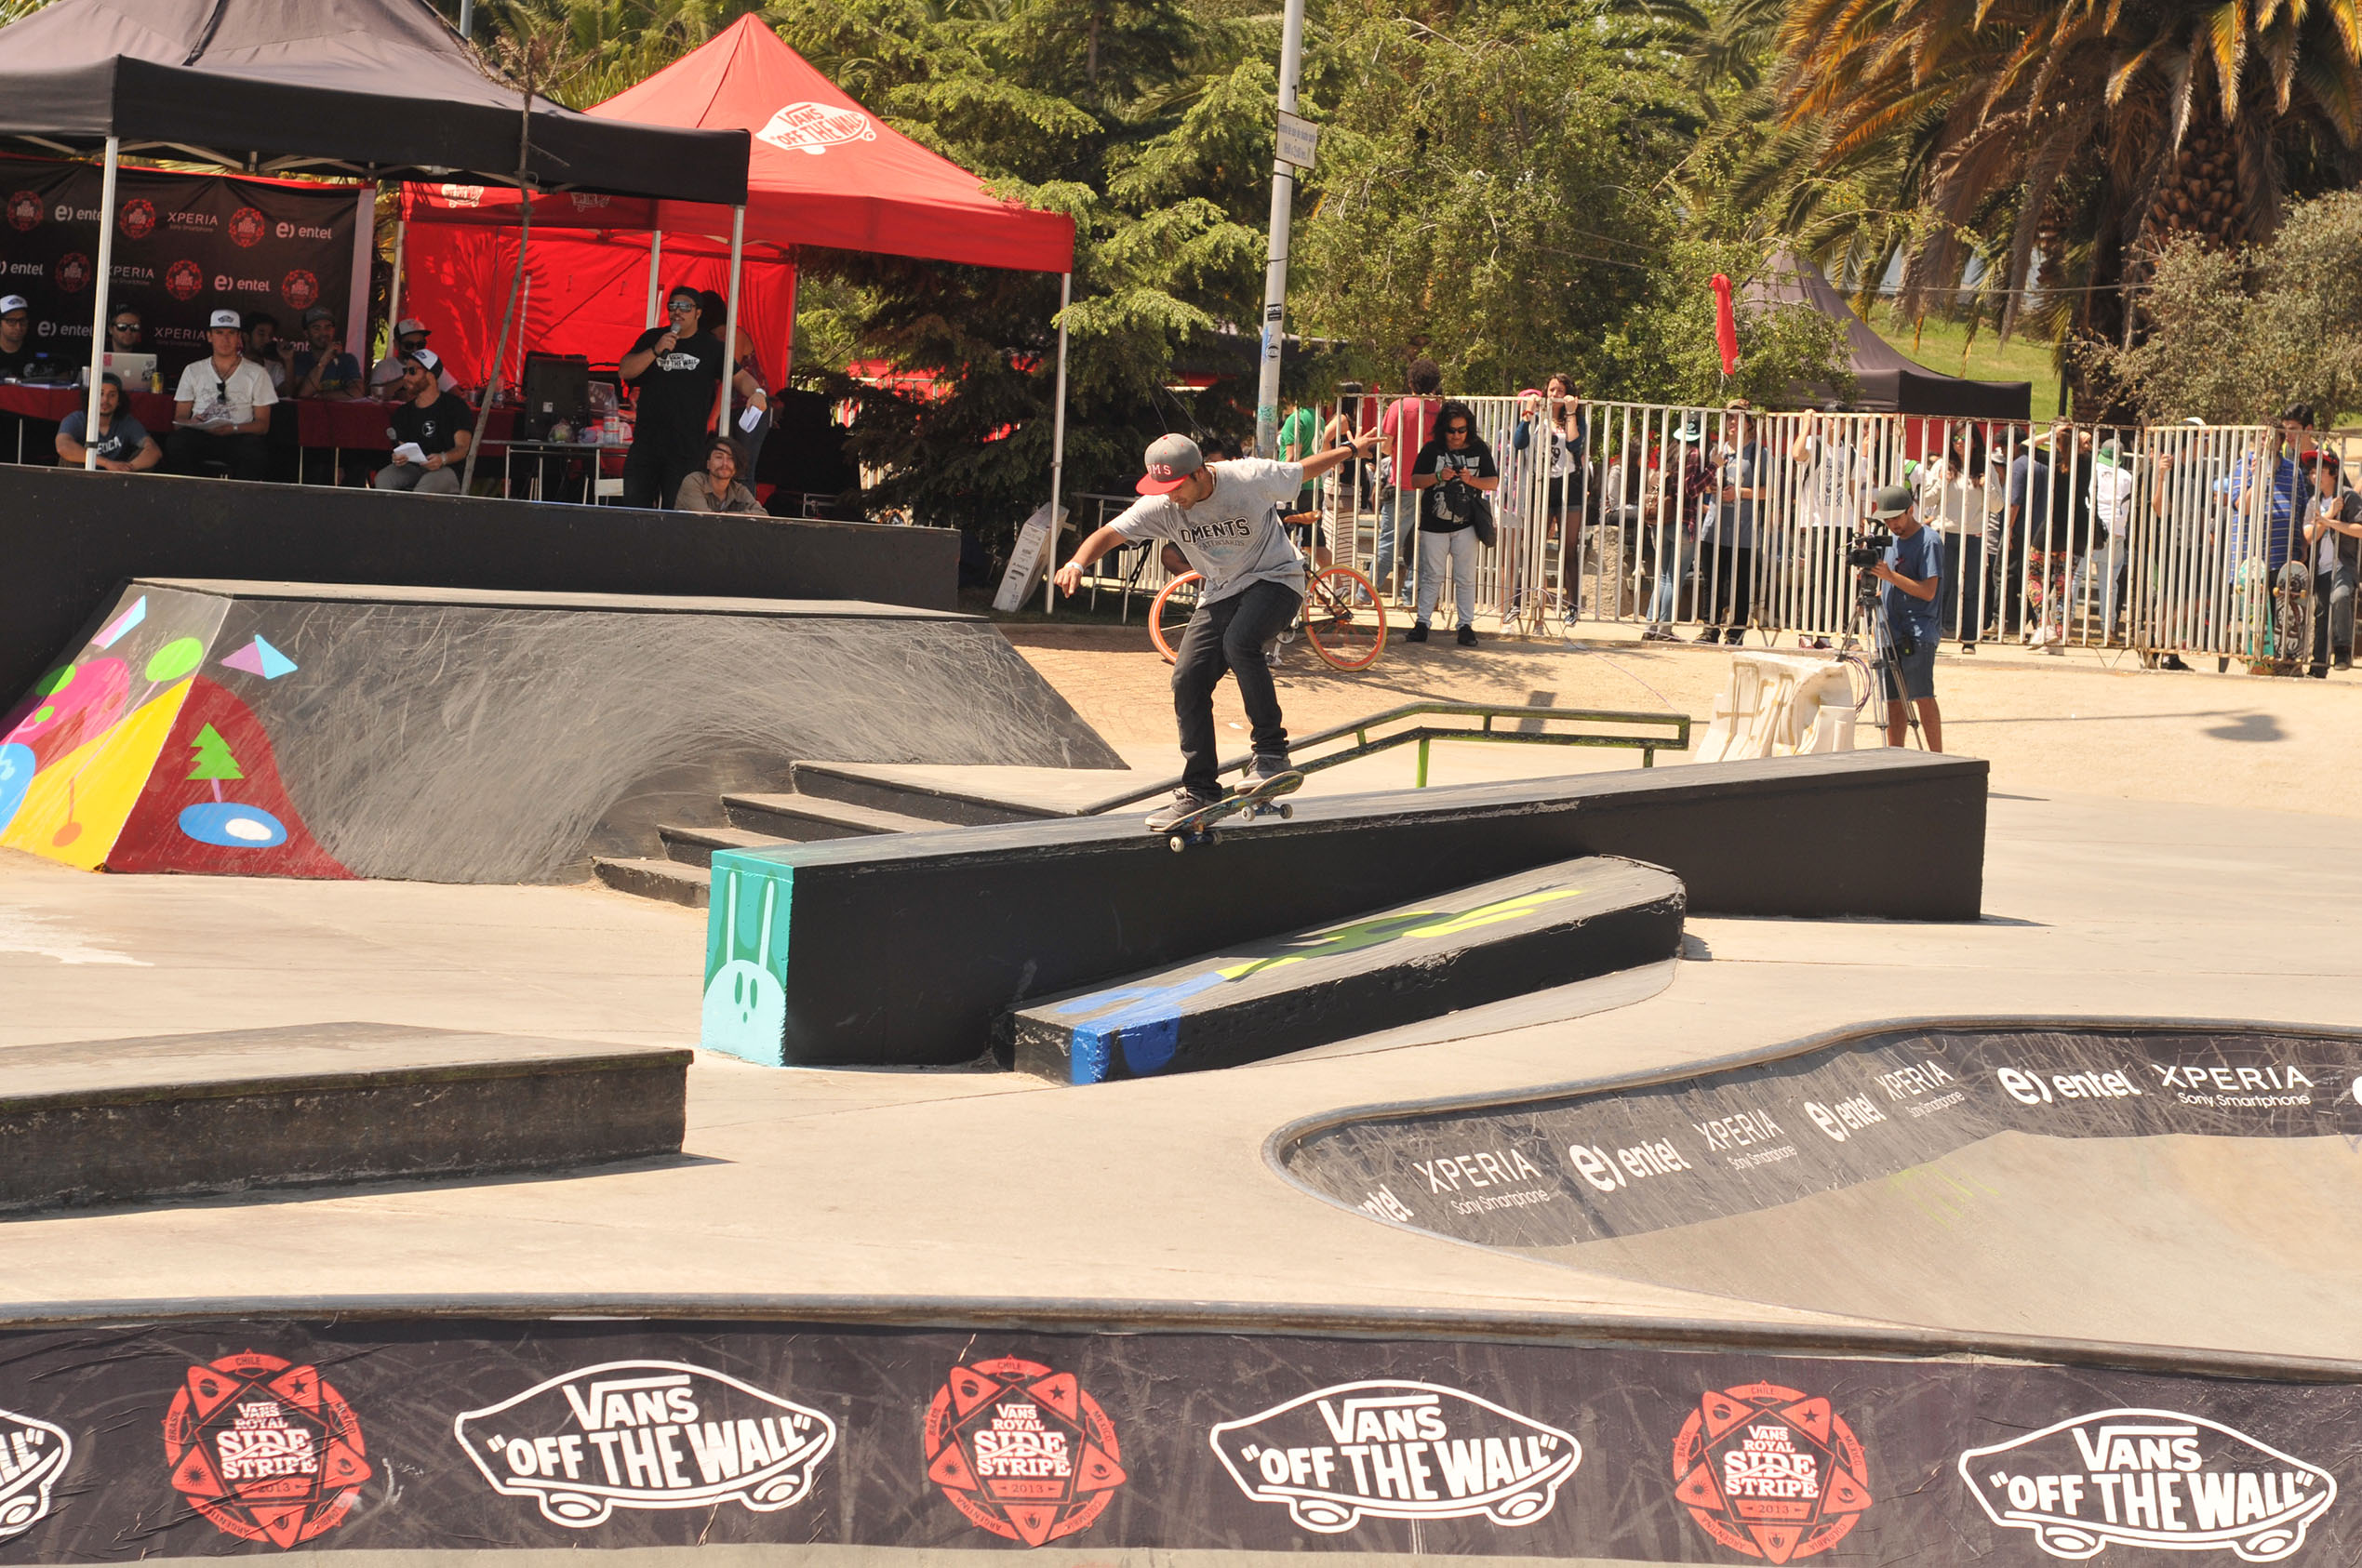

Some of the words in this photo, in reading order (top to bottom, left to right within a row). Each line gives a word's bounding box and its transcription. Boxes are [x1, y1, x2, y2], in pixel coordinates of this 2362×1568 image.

[777, 104, 825, 127] VANS
[799, 120, 842, 142] THE
[76, 208, 102, 221] ente
[167, 212, 219, 226] XPERIA
[298, 227, 333, 239] entel
[10, 263, 45, 276] entel
[236, 280, 271, 292] entel
[153, 327, 207, 341] XPERIA
[1874, 1060, 1955, 1102] XPERIA
[2052, 1070, 2142, 1099] entel
[2152, 1064, 2315, 1091] XPERIA
[1835, 1092, 1888, 1130] entel
[2177, 1092, 2213, 1108] Sony
[2218, 1094, 2312, 1109] Smartphone
[1692, 1108, 1785, 1152] XPERIA
[1617, 1137, 1692, 1178] entel
[1727, 1155, 1755, 1171] Sony
[1753, 1144, 1797, 1166] Smartphone
[1412, 1149, 1542, 1194] XPERIA
[1451, 1198, 1486, 1216] Sony
[1479, 1189, 1551, 1211] Smartphone
[234, 1357, 261, 1365] CHILE
[997, 1362, 1021, 1371] CHILE
[563, 1375, 699, 1430] VANS
[1751, 1387, 1775, 1395] CHILE
[237, 1402, 280, 1417] VANS
[996, 1403, 1037, 1419] VANS
[1316, 1394, 1448, 1444] VANS
[171, 1411, 180, 1441] BRASIL
[234, 1418, 288, 1429] ROYAL
[992, 1418, 1045, 1430] ROYAL
[1093, 1411, 1113, 1442] MEXICO
[1748, 1425, 1788, 1442] VANS
[217, 1428, 314, 1459] SIDE
[974, 1430, 1069, 1459] SIDE
[1677, 1430, 1691, 1458] BRASIL
[1742, 1440, 1795, 1453] ROYAL
[1843, 1435, 1862, 1467] MEXICO
[2072, 1426, 2203, 1472] VANS
[221, 1456, 318, 1480] STRIPE
[590, 1425, 692, 1488] THE
[977, 1457, 1072, 1477] STRIPE
[1724, 1450, 1818, 1480] SIDE
[1341, 1442, 1438, 1501] THE
[258, 1483, 291, 1494] 2013
[1012, 1484, 1044, 1494] 2013
[1726, 1479, 1820, 1499] STRIPE
[1758, 1505, 1790, 1514] 2013
[2091, 1472, 2187, 1532] THE
